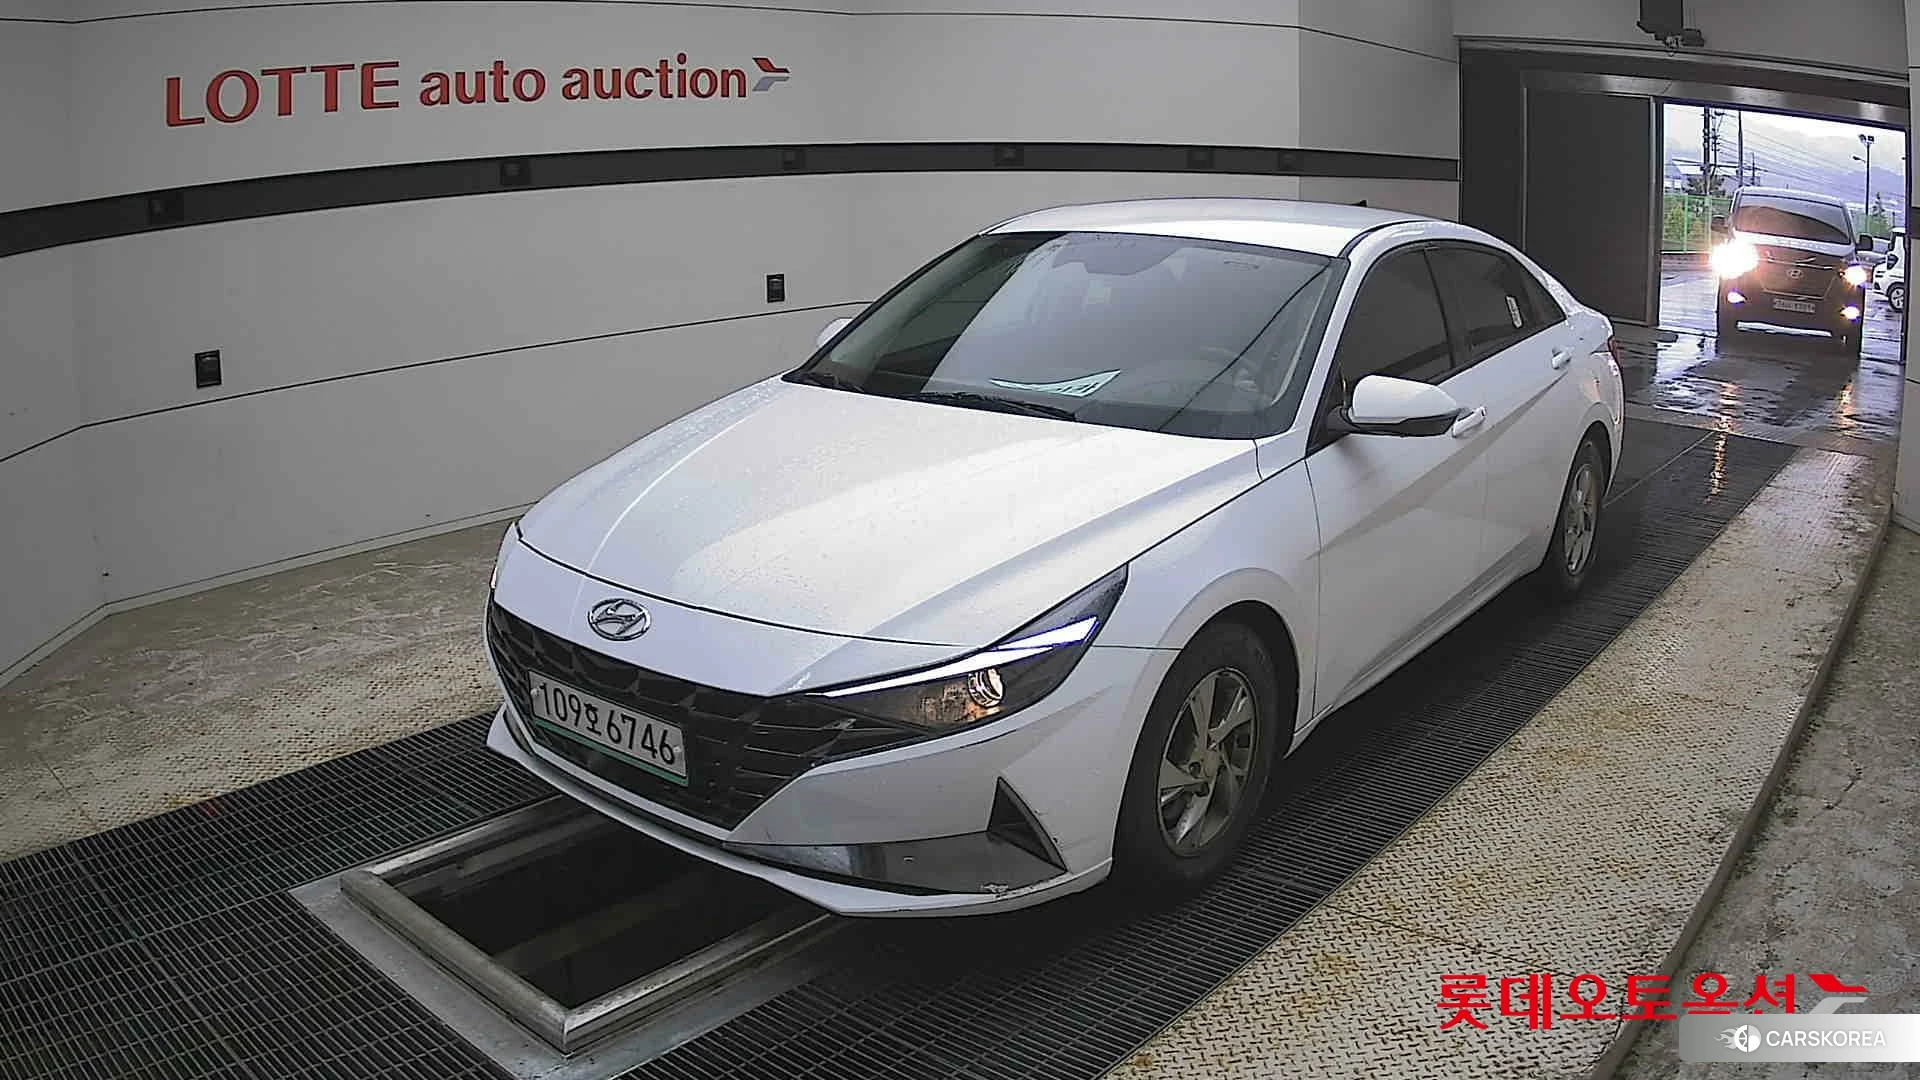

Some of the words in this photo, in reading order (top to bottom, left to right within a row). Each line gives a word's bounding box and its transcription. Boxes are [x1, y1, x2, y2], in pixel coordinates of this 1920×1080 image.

[166, 61, 399, 127] LOTTE
[419, 59, 546, 106] auto
[561, 52, 747, 100] auction
